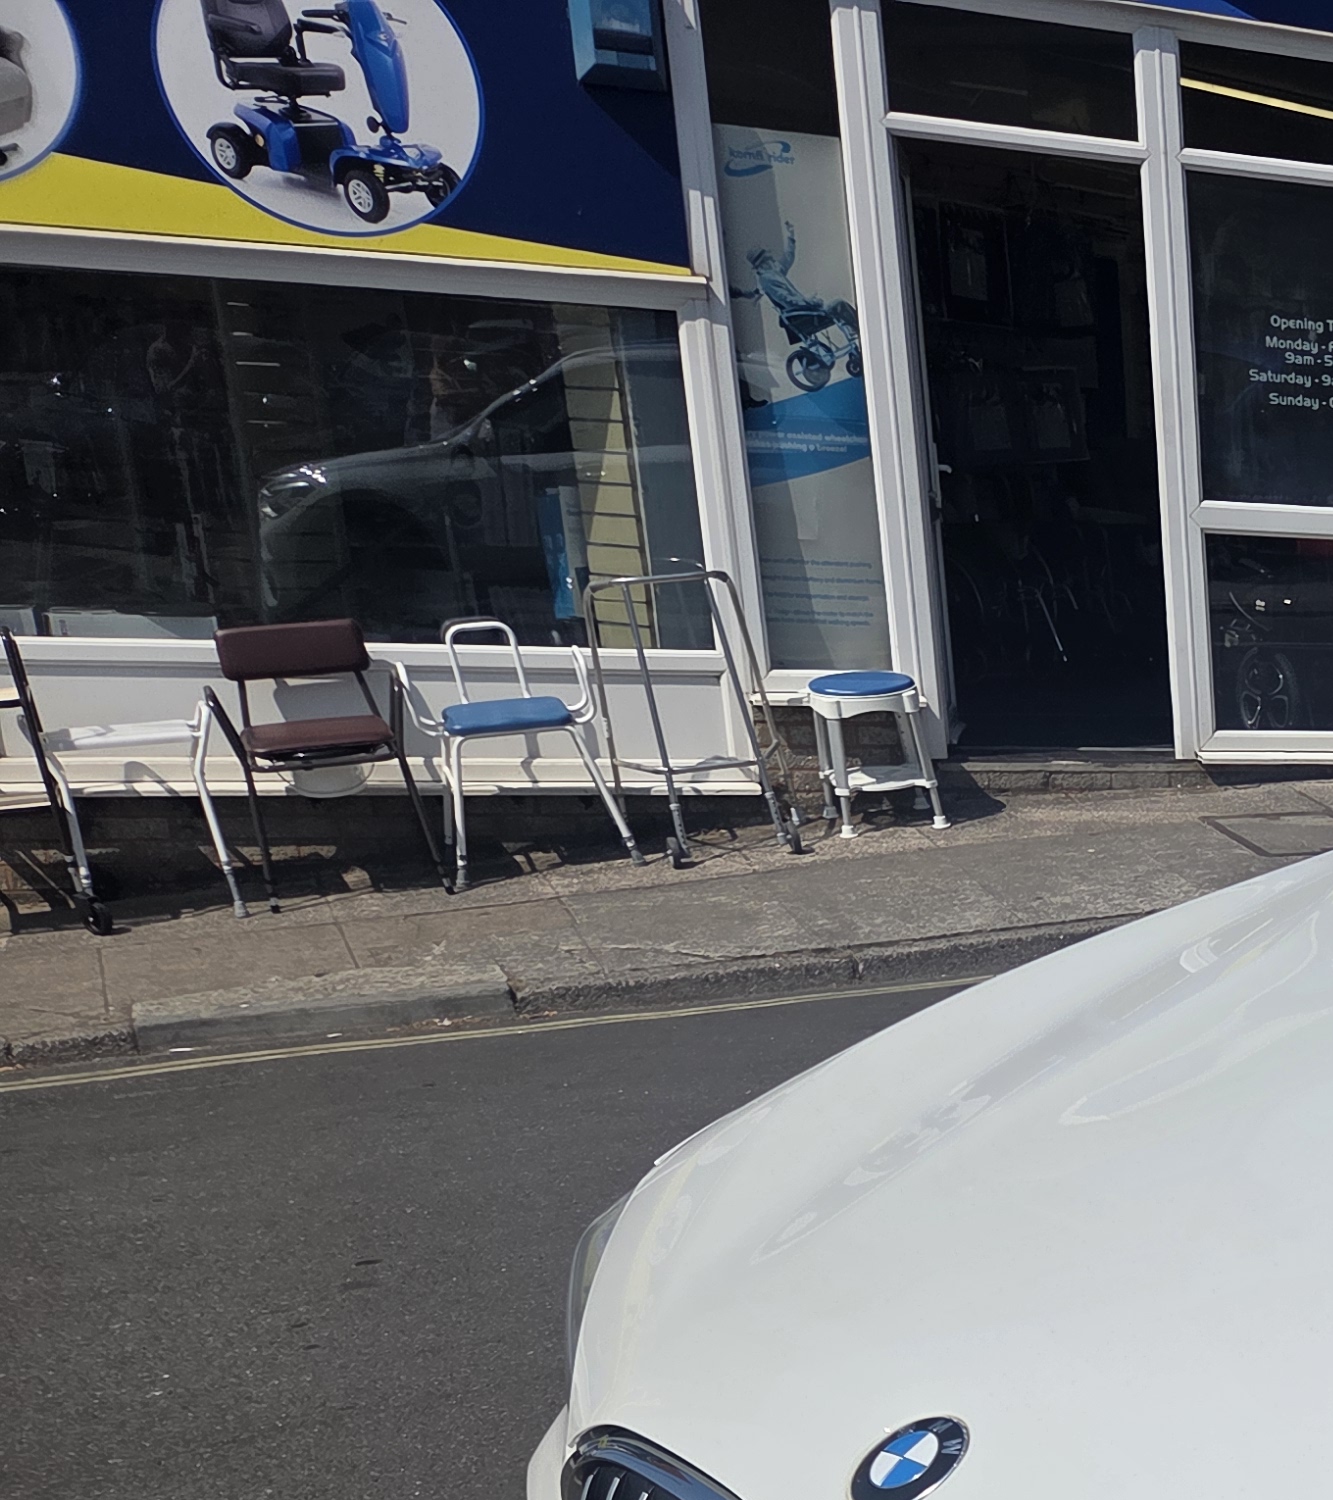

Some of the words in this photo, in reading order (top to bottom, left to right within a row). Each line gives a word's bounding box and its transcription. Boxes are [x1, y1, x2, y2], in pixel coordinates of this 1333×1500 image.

[1270, 315, 1324, 334] Opening
[1265, 336, 1318, 354] Monday
[1285, 352, 1314, 365] 9am
[1249, 369, 1312, 388] Saturday
[1269, 393, 1319, 410] Sunday
